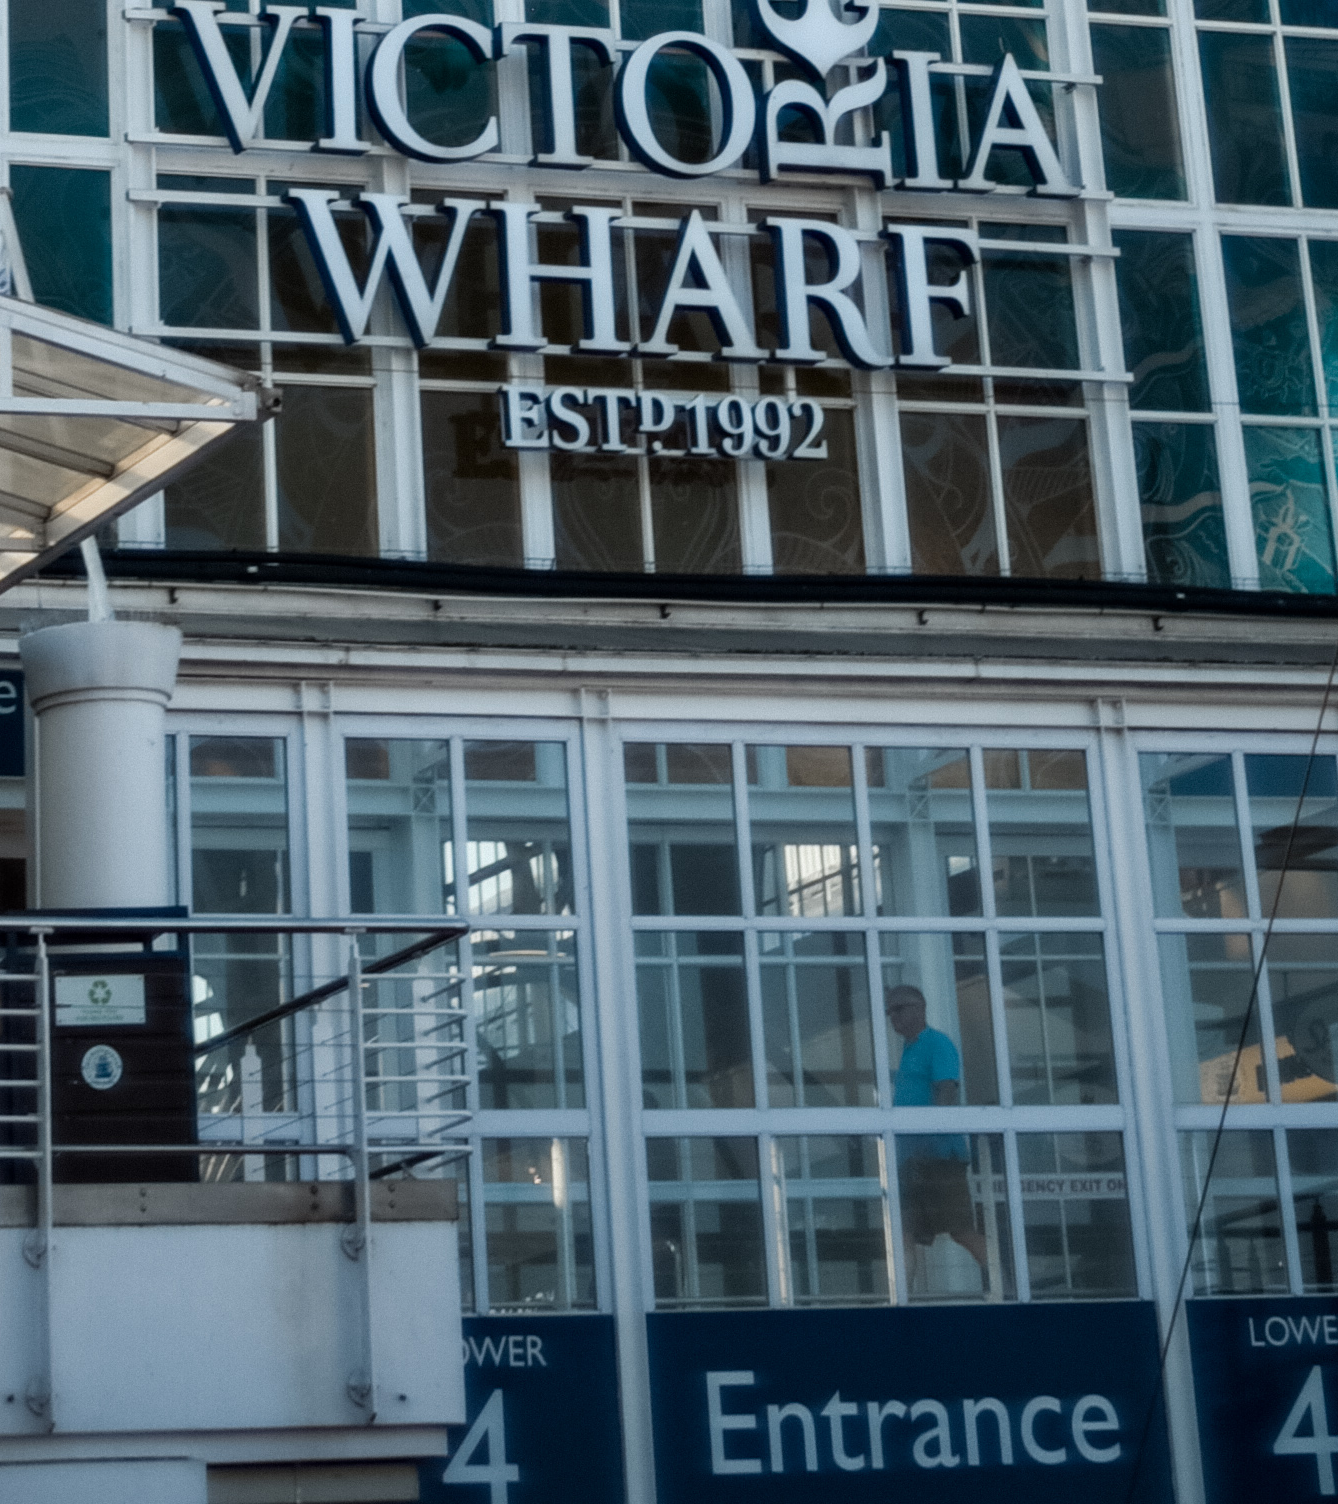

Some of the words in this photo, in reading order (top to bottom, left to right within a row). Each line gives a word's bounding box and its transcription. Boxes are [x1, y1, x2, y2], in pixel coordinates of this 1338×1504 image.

[284, 187, 979, 369] WHARF
[462, 1335, 548, 1367] WER
[442, 1388, 521, 1504] 4
[706, 1370, 1122, 1476] Entrance
